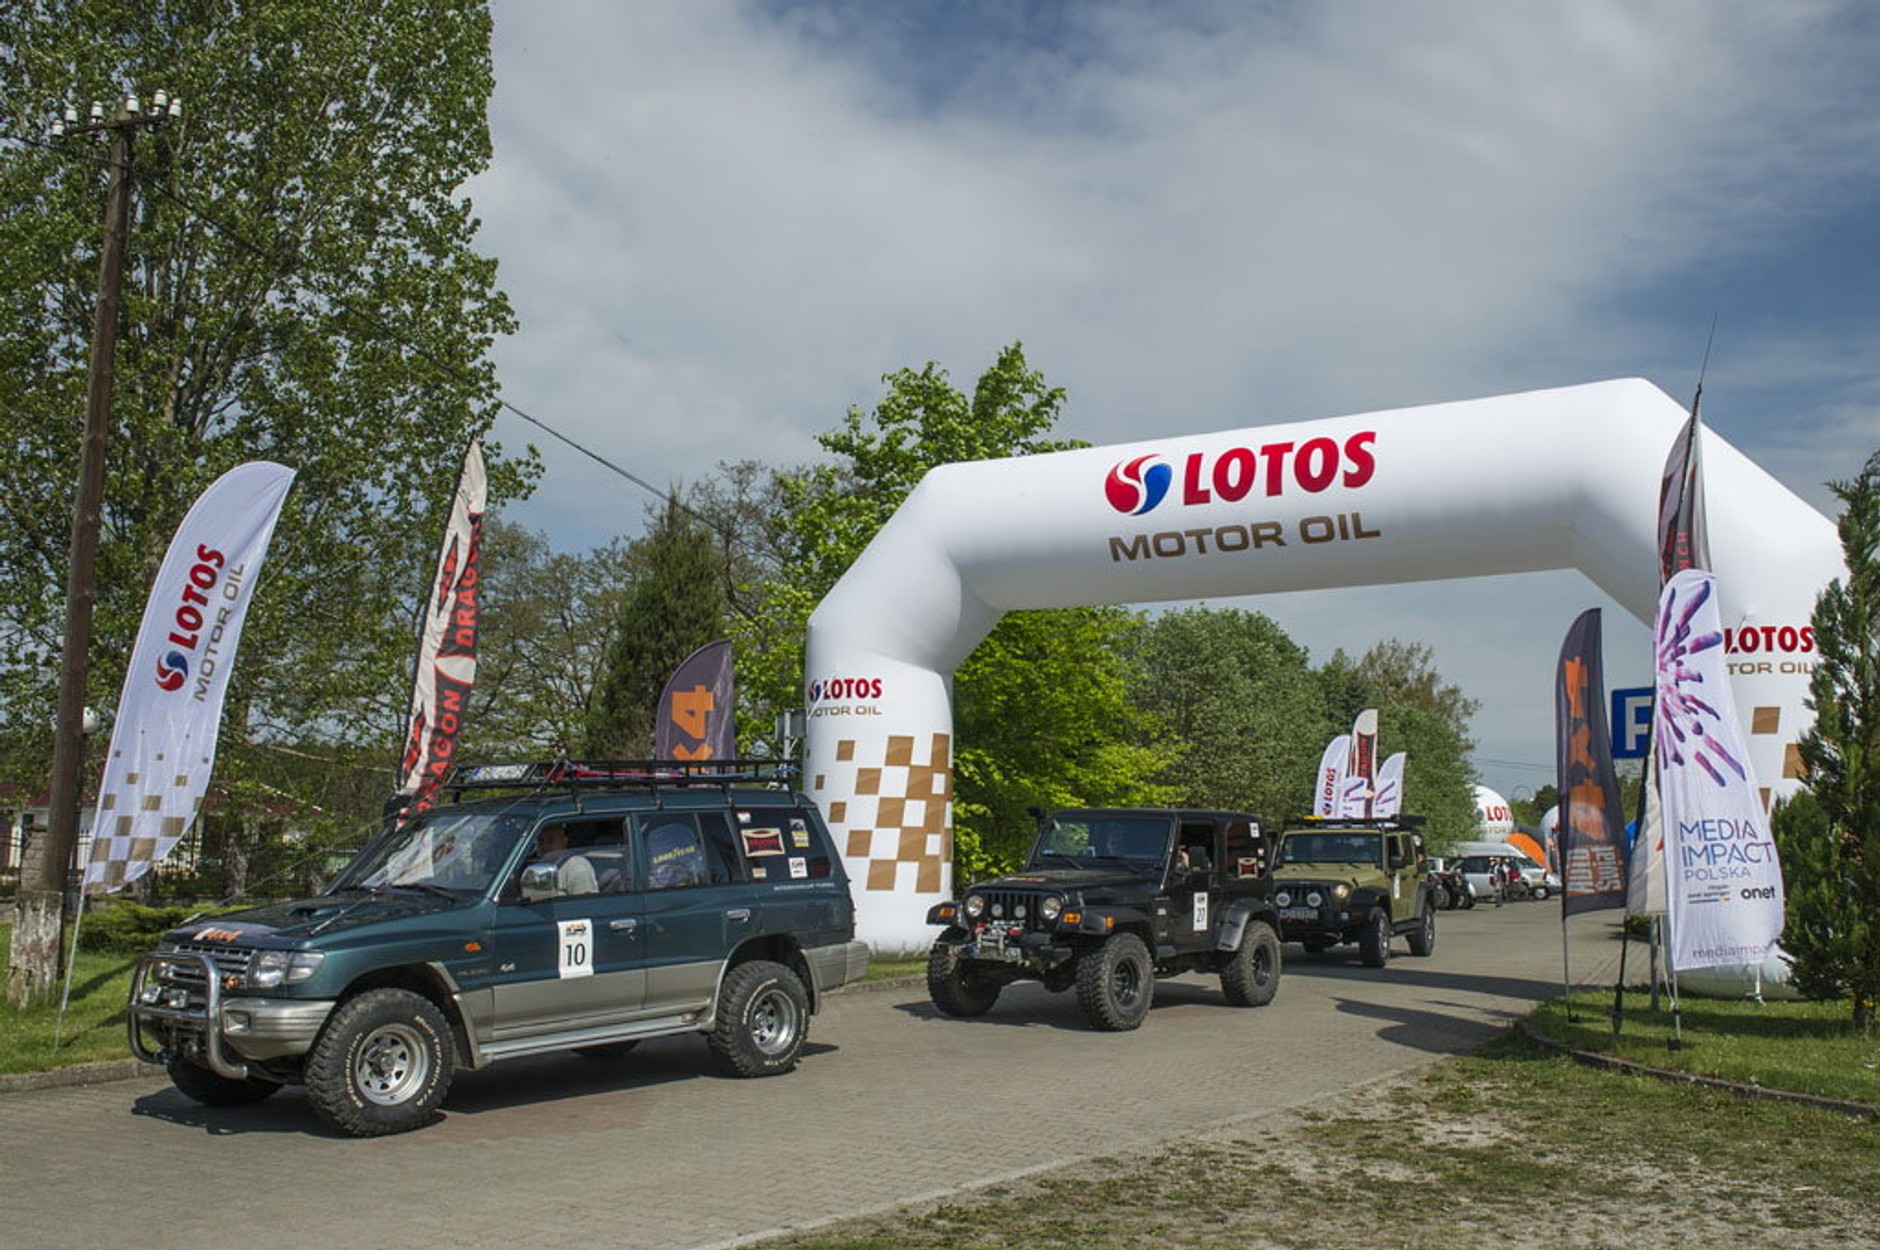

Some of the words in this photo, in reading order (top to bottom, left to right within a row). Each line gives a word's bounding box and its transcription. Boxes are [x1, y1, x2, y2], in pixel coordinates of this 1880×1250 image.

[1183, 431, 1377, 506] LOTOS
[1108, 521, 1287, 562] MOTOR
[1299, 512, 1382, 544] OIL
[168, 543, 226, 650] LOTOS
[193, 602, 234, 703] MOTOR
[224, 562, 246, 602] OIL
[1723, 626, 1814, 654] LOTOS
[1726, 662, 1773, 675] TOR
[823, 678, 883, 700] LOTOS
[855, 705, 882, 716] OIL
[1324, 768, 1337, 801] LOTOS
[1679, 819, 1758, 842] MEDIA
[1682, 842, 1773, 867] IMPACT
[1684, 867, 1751, 881] POLSKA
[1741, 886, 1775, 899] onet
[565, 942, 586, 967] 10
